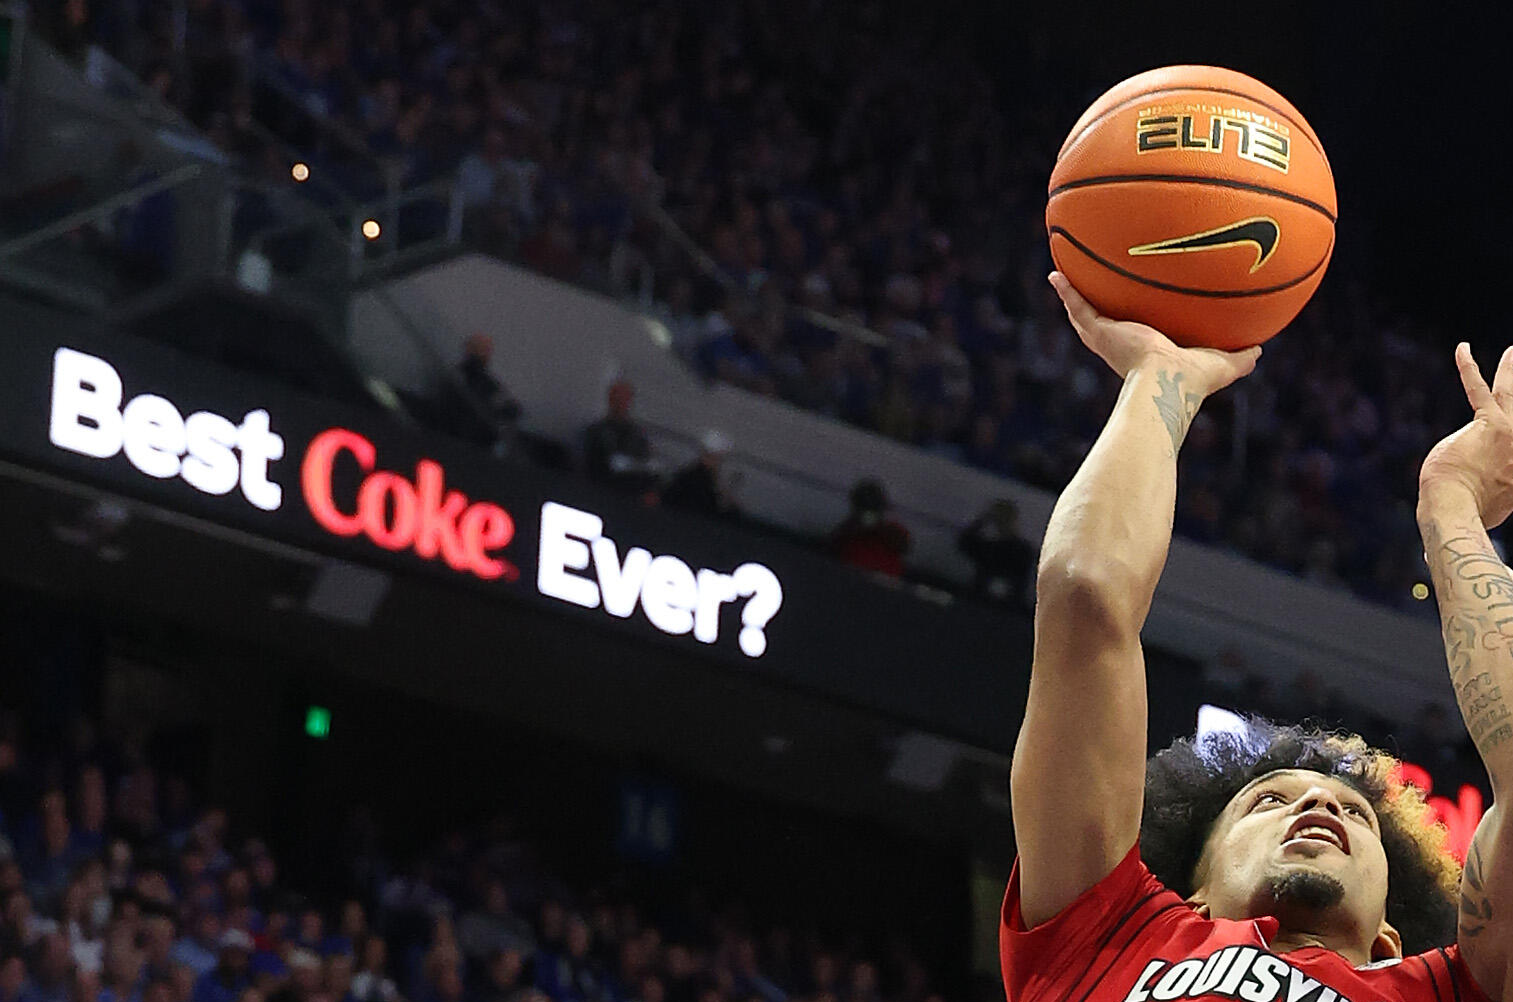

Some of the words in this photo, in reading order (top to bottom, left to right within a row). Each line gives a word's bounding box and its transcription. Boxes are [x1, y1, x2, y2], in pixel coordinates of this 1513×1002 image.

[48, 346, 284, 511] Best
[301, 428, 519, 582] Coke
[537, 501, 784, 657] Ever?
